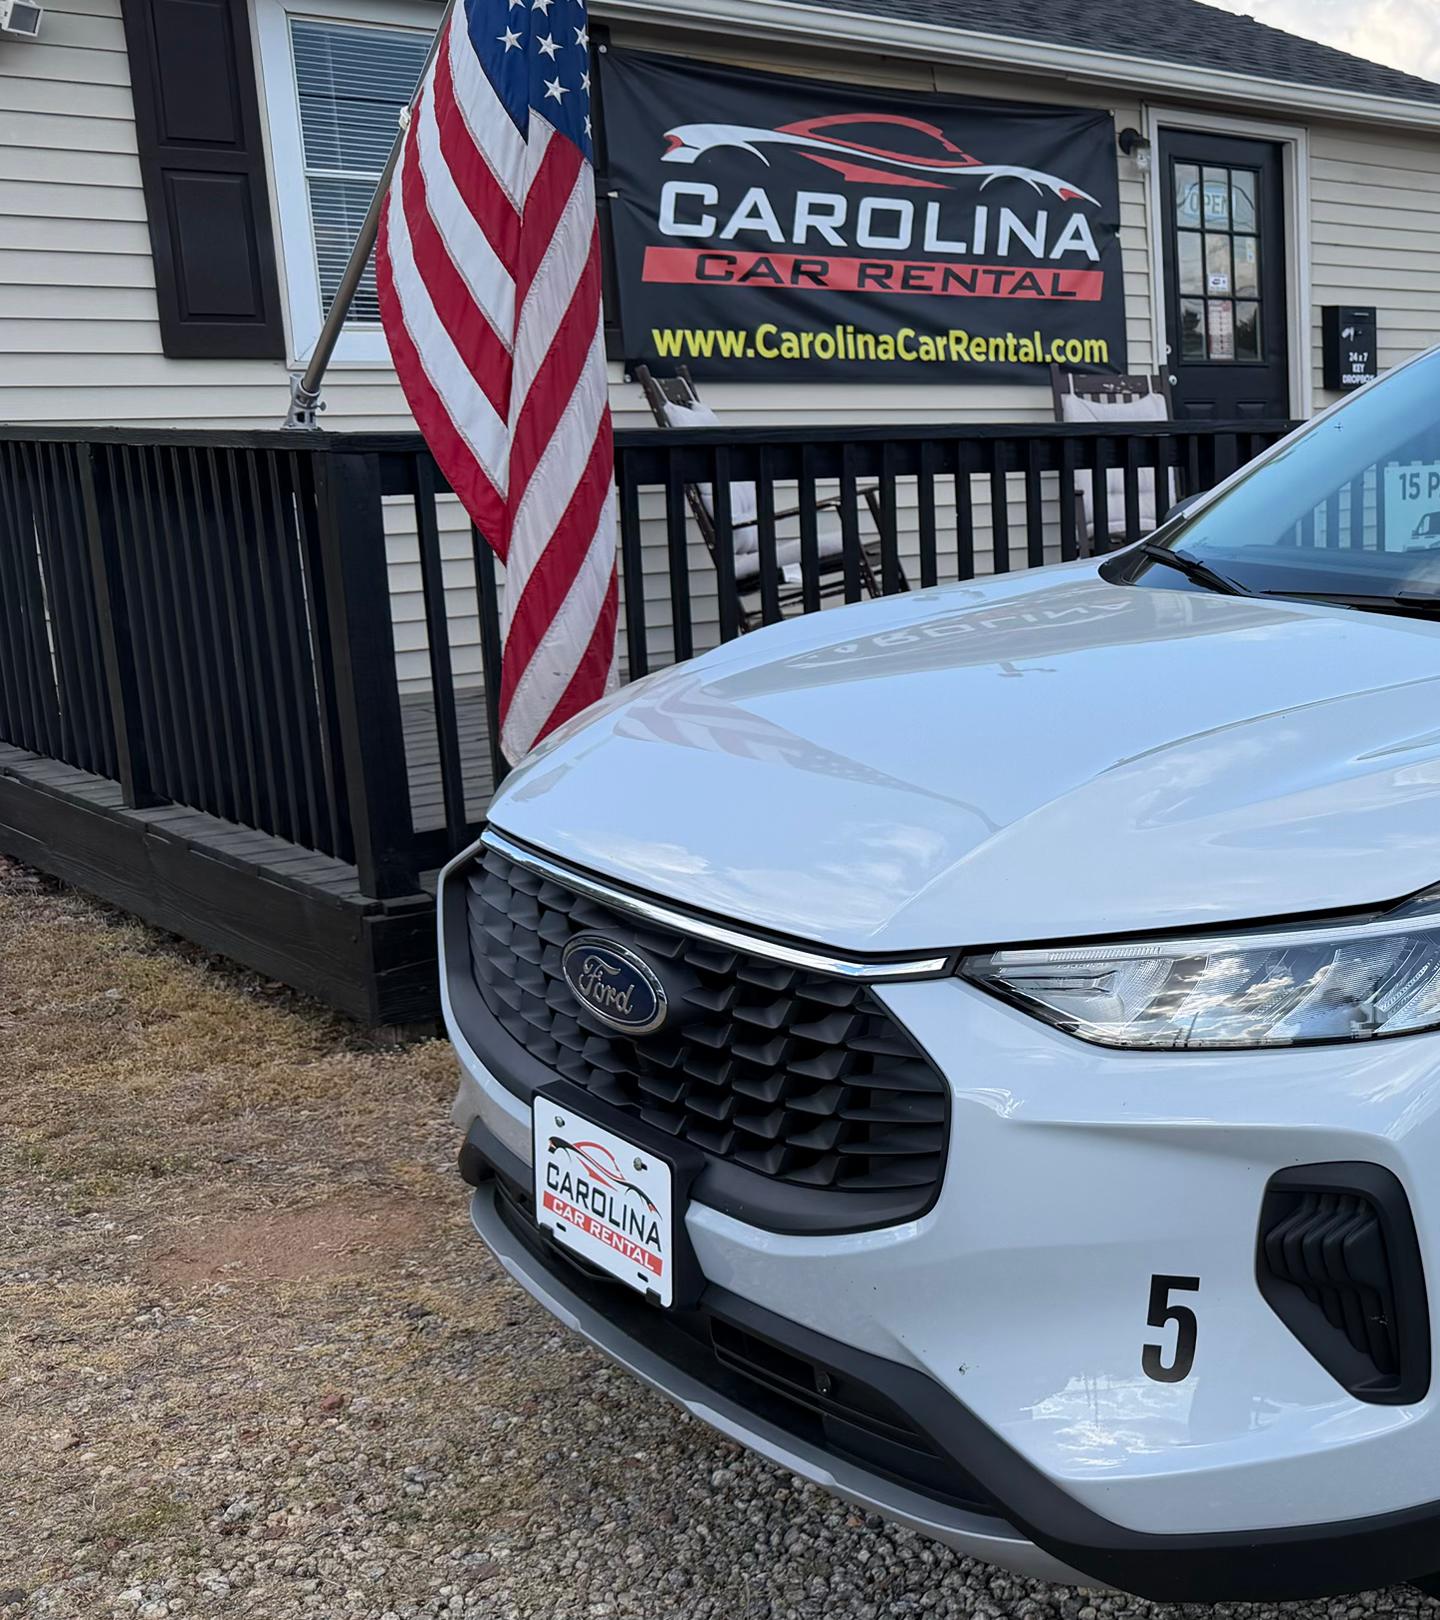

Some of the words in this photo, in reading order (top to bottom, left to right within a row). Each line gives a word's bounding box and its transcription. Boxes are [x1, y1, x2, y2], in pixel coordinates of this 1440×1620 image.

[657, 181, 1101, 261] CAROLINA
[694, 253, 830, 286] CAR
[856, 262, 1078, 298] RENTAL
[651, 323, 1110, 364] www.CarolinaCarRental.com
[1352, 363, 1365, 373] KEY
[1399, 472, 1421, 500] 15
[578, 954, 635, 1016] Ford
[546, 1162, 662, 1254] CAROLINA
[552, 1197, 585, 1229] CAR
[589, 1218, 655, 1271] RENTAL
[1141, 1274, 1201, 1383] 5
